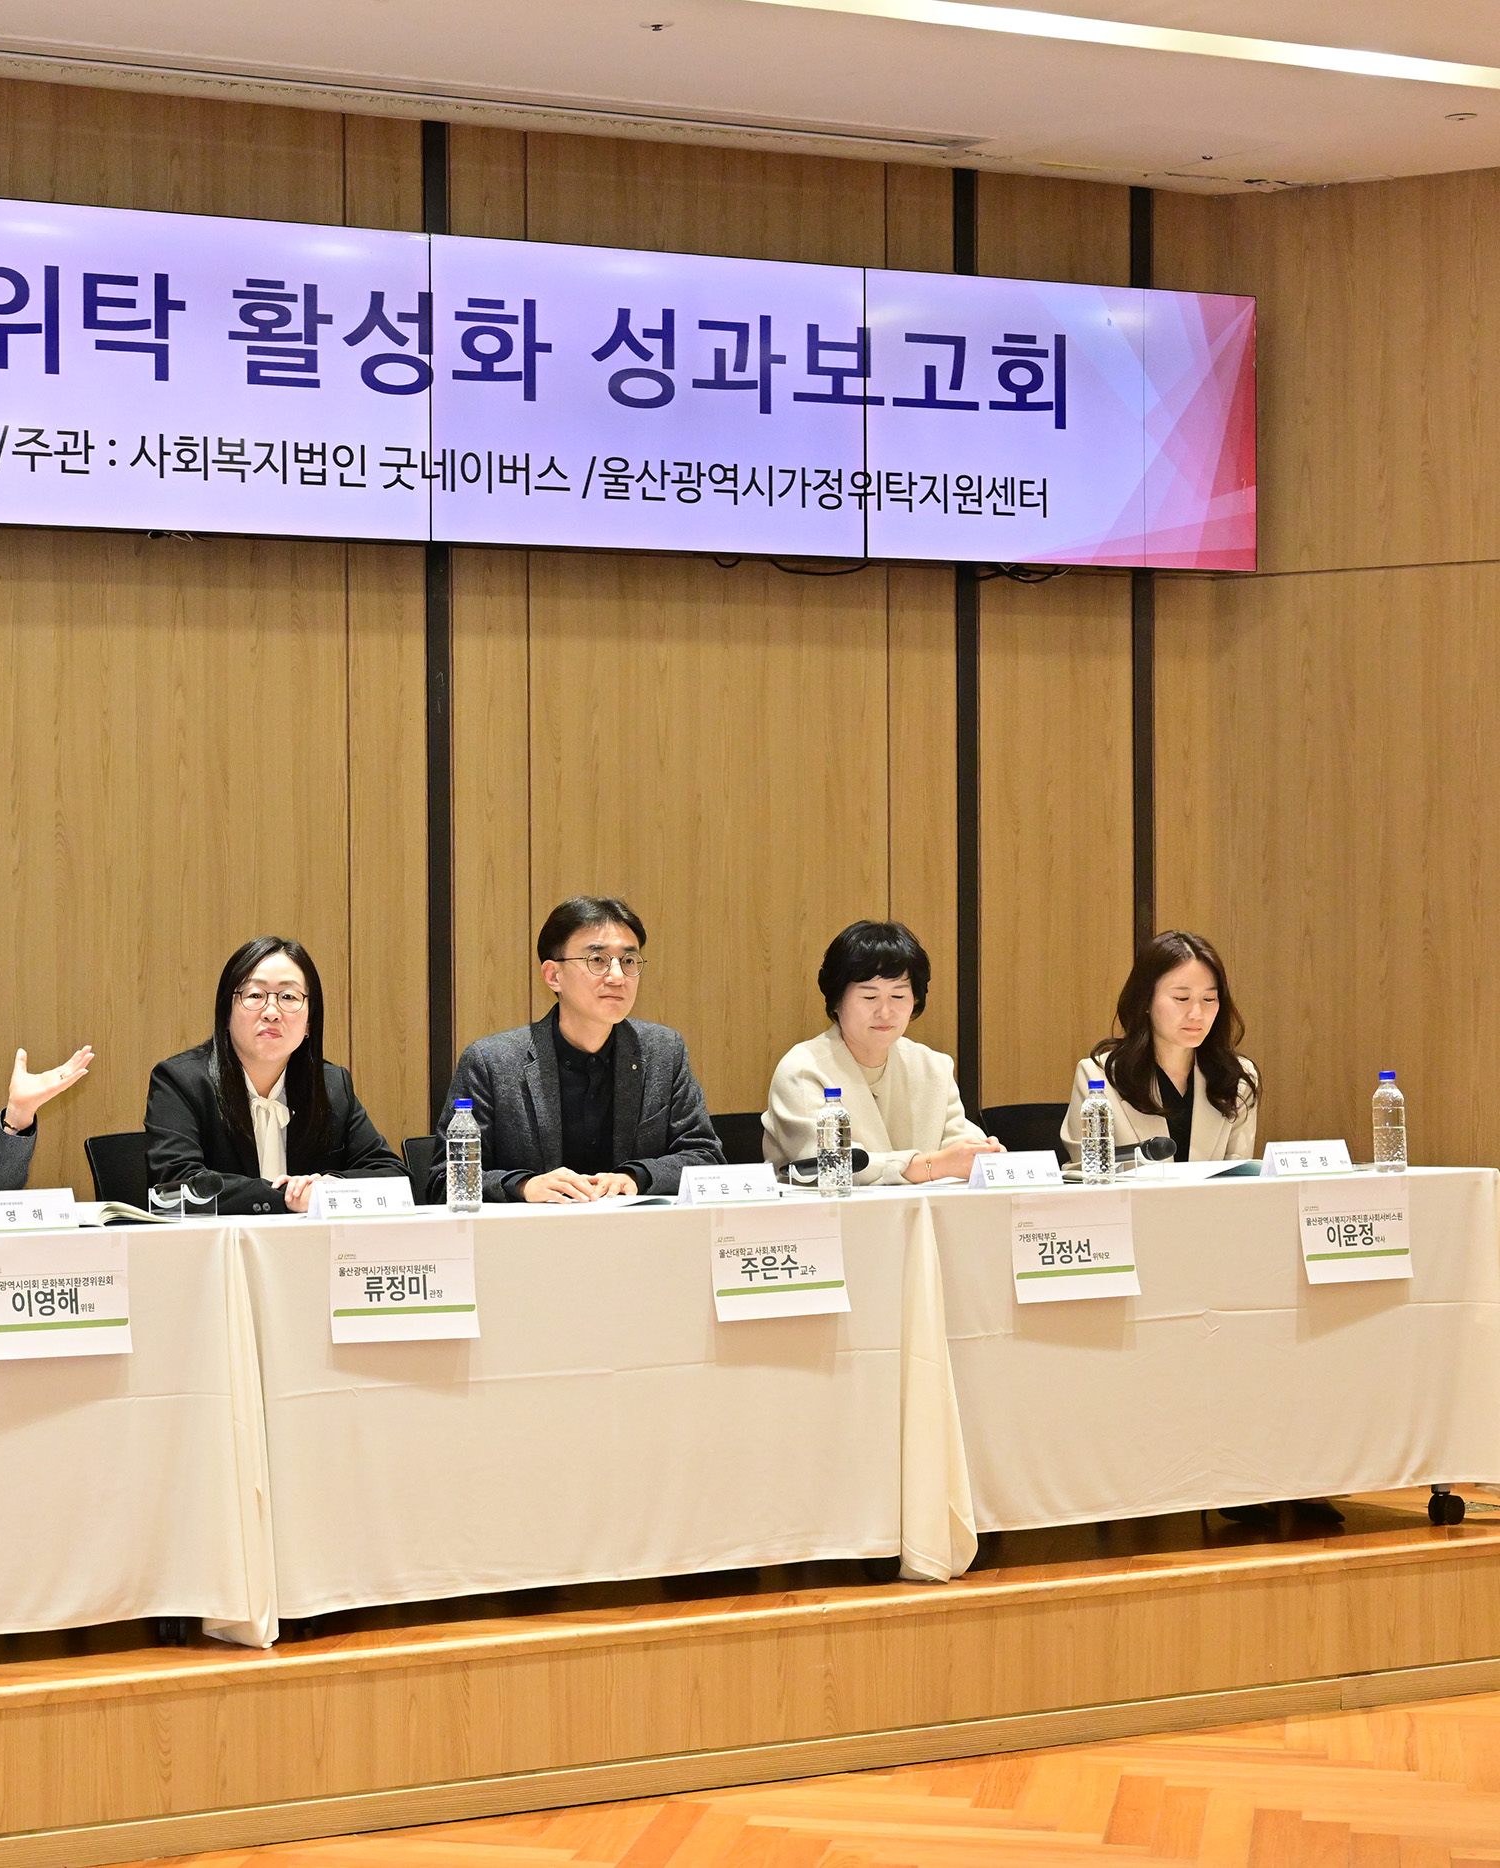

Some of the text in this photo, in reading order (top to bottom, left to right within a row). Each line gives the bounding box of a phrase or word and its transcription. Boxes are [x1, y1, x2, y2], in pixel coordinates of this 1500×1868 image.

[228, 278, 552, 401] 활성화
[591, 307, 1067, 430] 성과보고회
[129, 433, 367, 488] 사회복지법인
[379, 445, 571, 496] 굿네이버스
[1327, 1222, 1374, 1247] 이윤정
[719, 1247, 753, 1259] 울산대학교
[1038, 1239, 1092, 1265] 김정선
[338, 1264, 437, 1277] 울산광역시가정위탁지원센터
[741, 1254, 817, 1281] 주은수 교수
[41, 1276, 114, 1290] 문화복지환경위원회
[364, 1274, 428, 1302] 류정미
[12, 1287, 95, 1317] 이영해 위원
